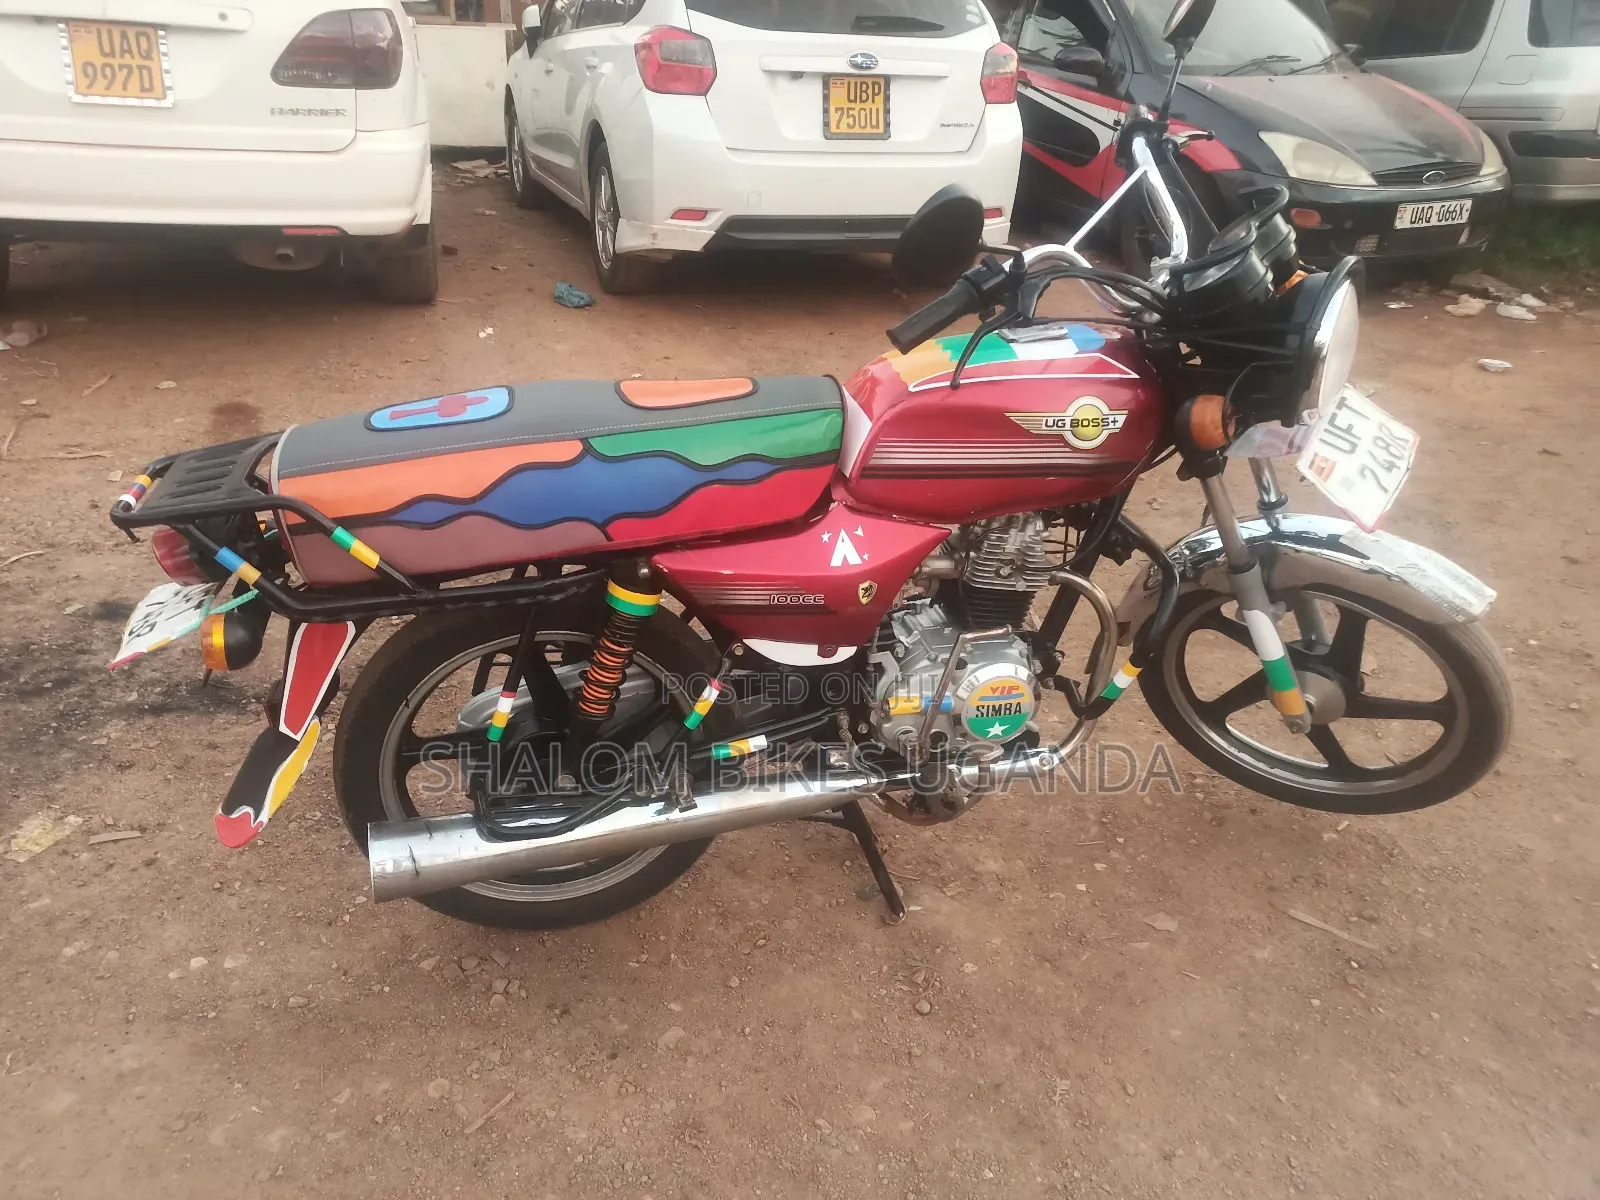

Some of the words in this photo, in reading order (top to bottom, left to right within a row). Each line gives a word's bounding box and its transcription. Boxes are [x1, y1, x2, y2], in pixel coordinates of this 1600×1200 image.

[97, 28, 154, 60] UAQ
[82, 61, 156, 94] 997D
[846, 80, 882, 104] UBP
[270, 107, 348, 117] HARRIER
[834, 107, 880, 130] 750U
[1409, 205, 1434, 225] UAQ
[1437, 202, 1466, 223] 066X
[1044, 418, 1067, 429] UG
[1069, 416, 1119, 429] BOSS+
[1319, 396, 1371, 455] UFT
[769, 593, 825, 605] 100CC
[989, 685, 1020, 695] VIP
[975, 701, 1022, 718] SIMBA
